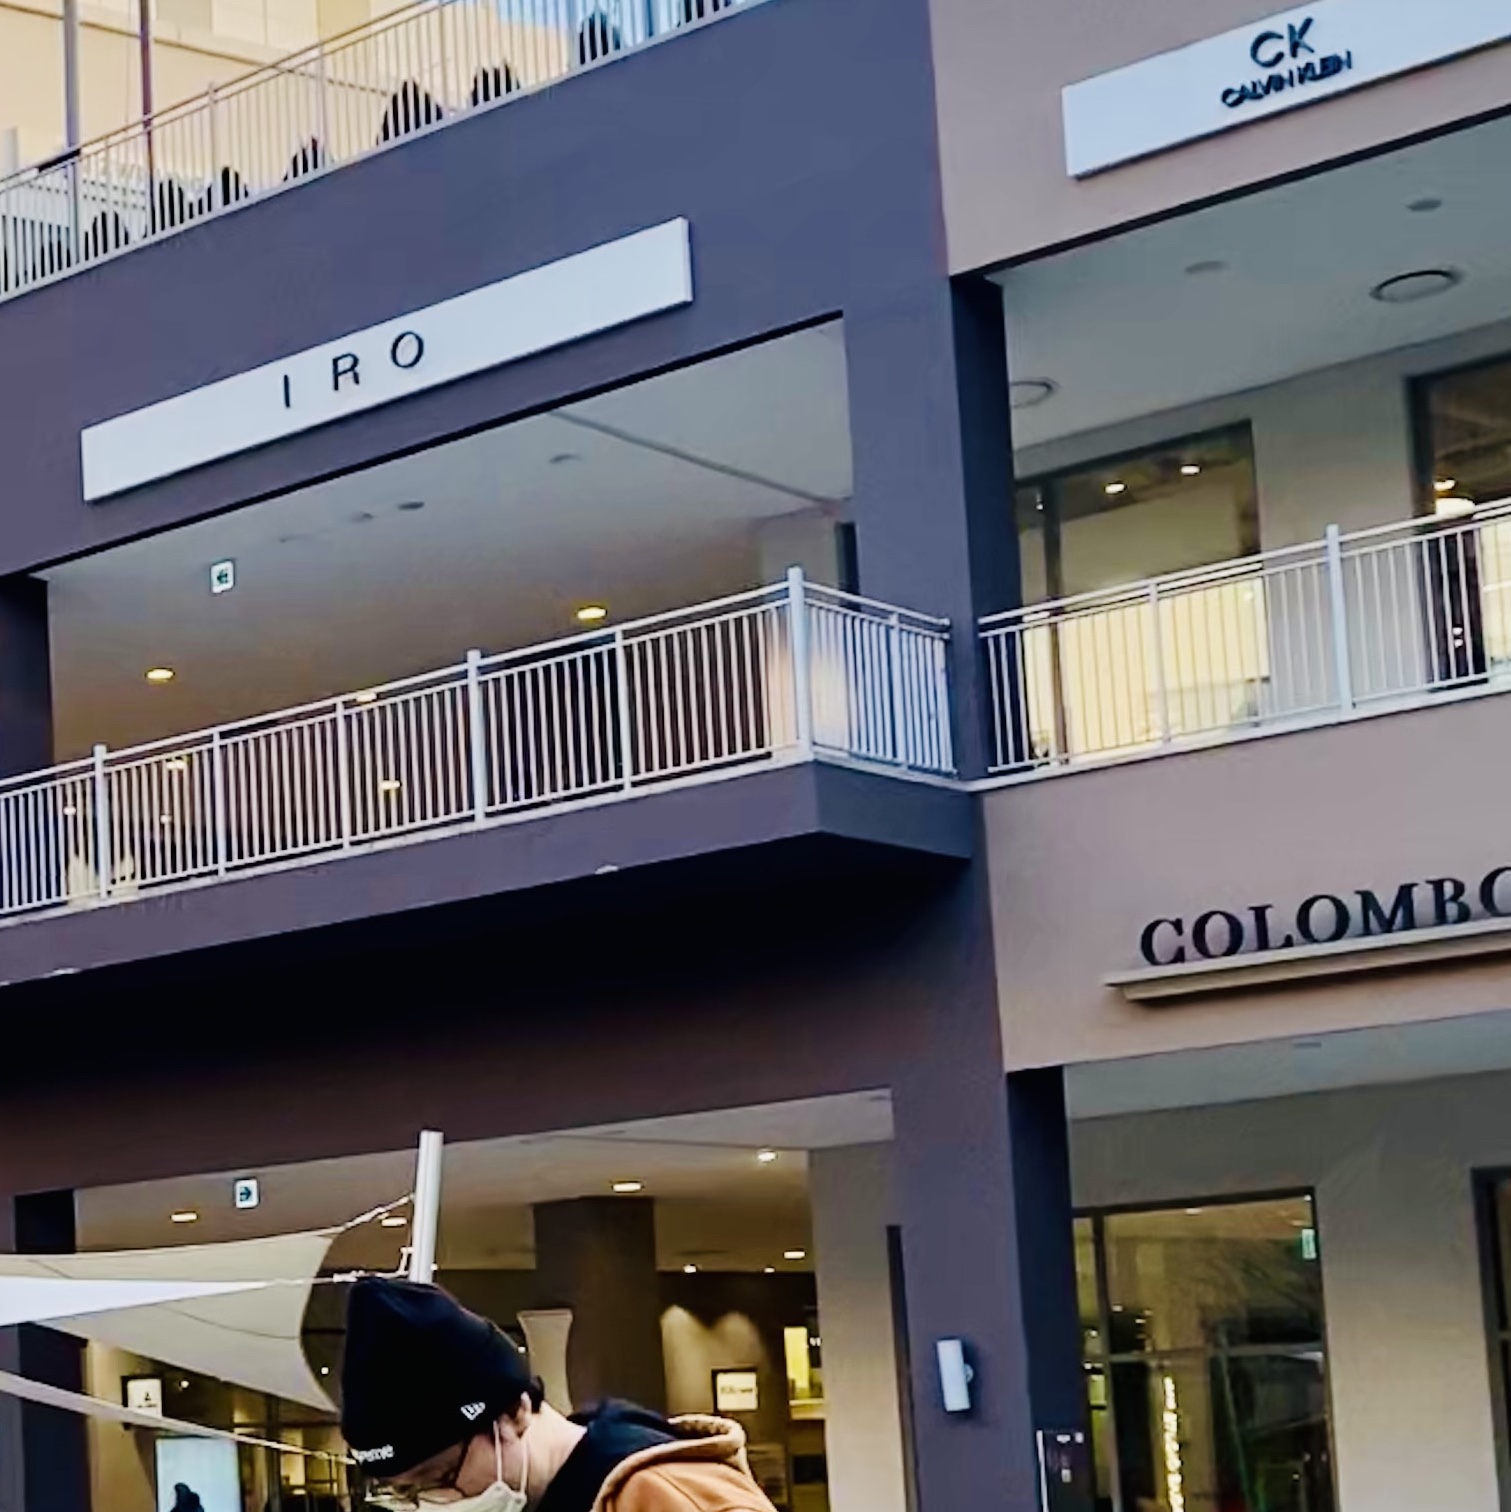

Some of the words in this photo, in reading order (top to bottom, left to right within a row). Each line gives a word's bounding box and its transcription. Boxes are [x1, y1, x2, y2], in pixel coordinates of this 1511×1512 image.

[1249, 15, 1315, 69] CK
[1220, 69, 1295, 109] CALVIN
[1296, 49, 1353, 85] KLEIN
[282, 330, 425, 409] IRO
